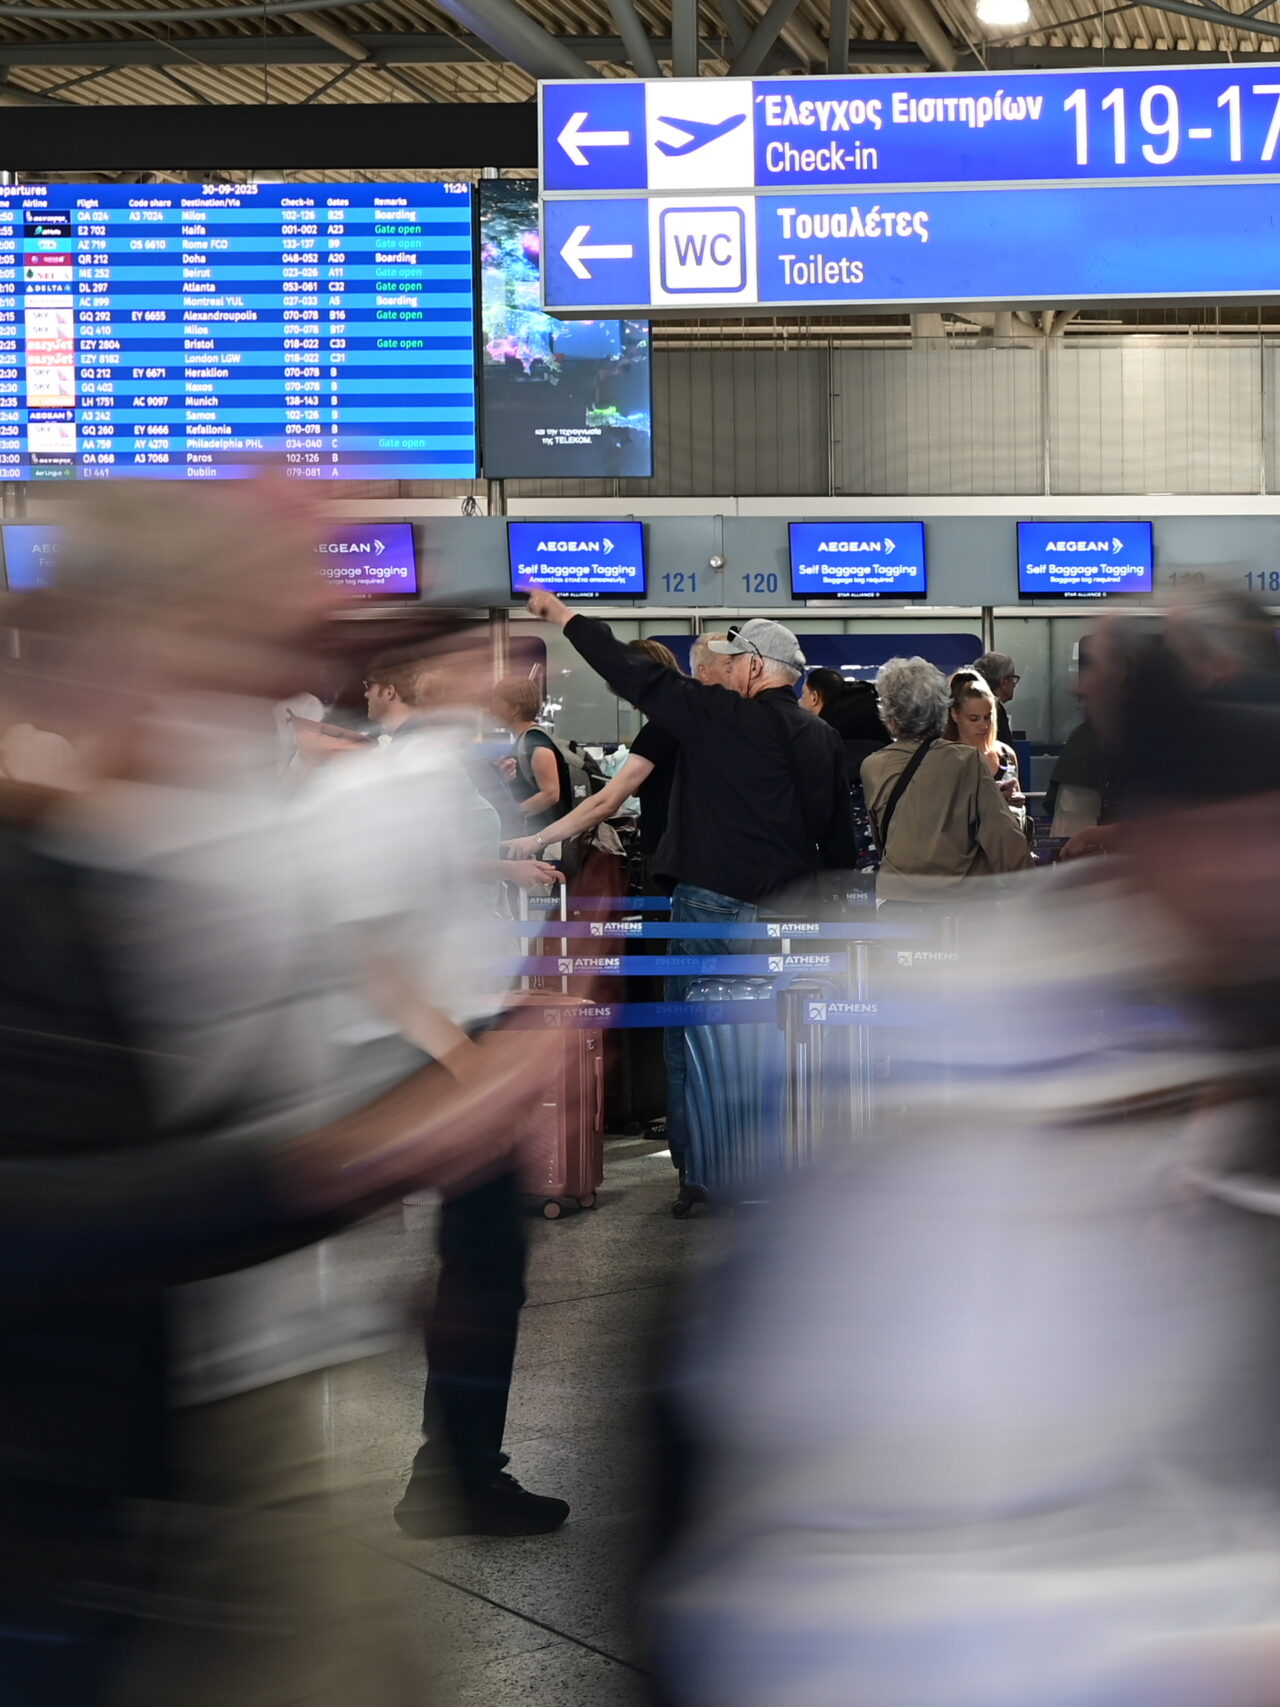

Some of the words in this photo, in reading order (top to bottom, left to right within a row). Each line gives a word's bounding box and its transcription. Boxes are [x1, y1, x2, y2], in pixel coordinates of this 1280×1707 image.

[755, 95, 882, 131] Έλεγχος
[892, 90, 1043, 128] Εισιτηρίων
[765, 141, 878, 172] Check-in
[202, 184, 258, 195] 30-09-2025
[443, 183, 468, 194] 11:24
[22, 199, 48, 208] Airline
[77, 199, 99, 209] Flight
[129, 199, 148, 207] Code
[150, 199, 172, 207] share
[181, 198, 241, 208] Destination/Via
[281, 198, 314, 206] Check-in
[327, 198, 349, 206] Gates
[374, 198, 407, 206] Remarks
[89, 225, 106, 236] 702
[181, 224, 206, 235] Haifa
[281, 224, 318, 235] 001-002
[327, 224, 344, 235] A23
[374, 224, 396, 234] Gate
[397, 226, 422, 236] open
[776, 205, 929, 243] Τουαλέτες
[673, 233, 732, 267] WC
[78, 254, 92, 265] QR
[93, 254, 109, 264] 212
[182, 253, 207, 264] Doha
[282, 253, 319, 263] 048-052
[327, 253, 346, 263] A20
[375, 252, 417, 265] Boarding
[777, 254, 864, 285] Toilets
[79, 282, 92, 293] DL
[92, 282, 108, 293] 297
[182, 282, 216, 293] Atlanta
[282, 281, 318, 292] 053-061
[328, 281, 345, 292] C32
[375, 281, 397, 291] Gate
[398, 283, 422, 292] open
[79, 311, 94, 322] GQ
[95, 311, 111, 322] 292
[131, 311, 143, 321] EY
[183, 310, 258, 322] Alexandroupolis
[283, 310, 319, 320] 070-078
[329, 310, 346, 320] B16
[376, 310, 398, 320] Gate
[399, 311, 423, 321] open
[80, 339, 97, 350] EZY
[98, 339, 121, 350] 2804
[184, 338, 215, 350] Bristol
[283, 338, 319, 349] 018-022
[329, 338, 346, 349] C33
[376, 338, 398, 348] Gate
[399, 340, 424, 349] open
[80, 368, 95, 379] GQ
[96, 368, 111, 378] 212
[132, 368, 145, 378] EY
[184, 367, 229, 378] Heraklion
[284, 367, 320, 377] 070-078
[330, 367, 338, 377] B
[81, 397, 94, 407] LH
[95, 396, 114, 407] 1751
[132, 396, 146, 407] AC
[146, 396, 169, 407] 9097
[185, 396, 219, 407] Munich
[330, 395, 338, 406] B
[82, 425, 96, 436] GQ
[97, 425, 115, 435] 260
[134, 425, 146, 435] EY
[186, 424, 232, 435] Kefallonia
[285, 424, 321, 434] 070-078
[331, 424, 339, 434] B
[537, 541, 600, 552] AEGEAN
[817, 541, 881, 552] AEGEAN
[1045, 541, 1109, 552] AEGEAN
[317, 567, 362, 578] aggage
[363, 565, 408, 578] Tagging
[518, 563, 538, 574] Self
[541, 563, 590, 577] Baggage
[591, 564, 636, 577] Tagging
[799, 564, 819, 575] Self
[821, 564, 871, 577] Baggage
[872, 564, 917, 576] Tagging
[1026, 564, 1047, 574] Self
[1048, 564, 1098, 576] Baggage
[1100, 564, 1144, 576] Tagging
[662, 573, 697, 593] 121
[742, 573, 778, 593] 120
[1244, 571, 1280, 591] 118
[603, 922, 643, 932] ATHENS
[781, 923, 820, 933] ATHENS
[573, 957, 620, 968] ATHENS
[785, 955, 830, 966] ATHENS
[828, 1002, 878, 1014] ATHENS
